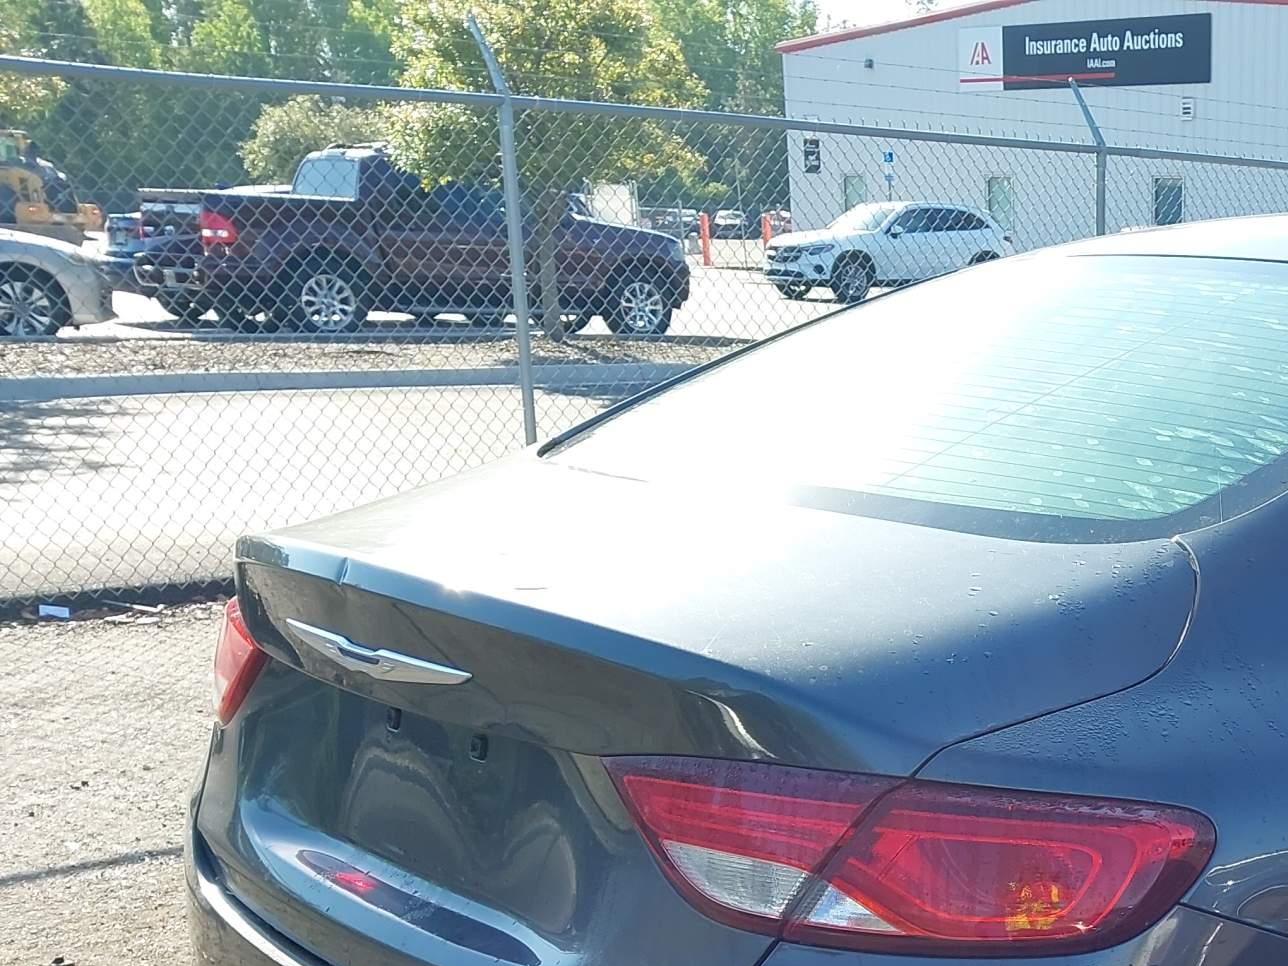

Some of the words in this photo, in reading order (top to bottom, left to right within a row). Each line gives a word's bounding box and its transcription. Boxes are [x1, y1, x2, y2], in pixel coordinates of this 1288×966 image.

[1025, 35, 1087, 56] Insurance
[1090, 32, 1121, 52] Auto
[1123, 28, 1184, 51] Auctions
